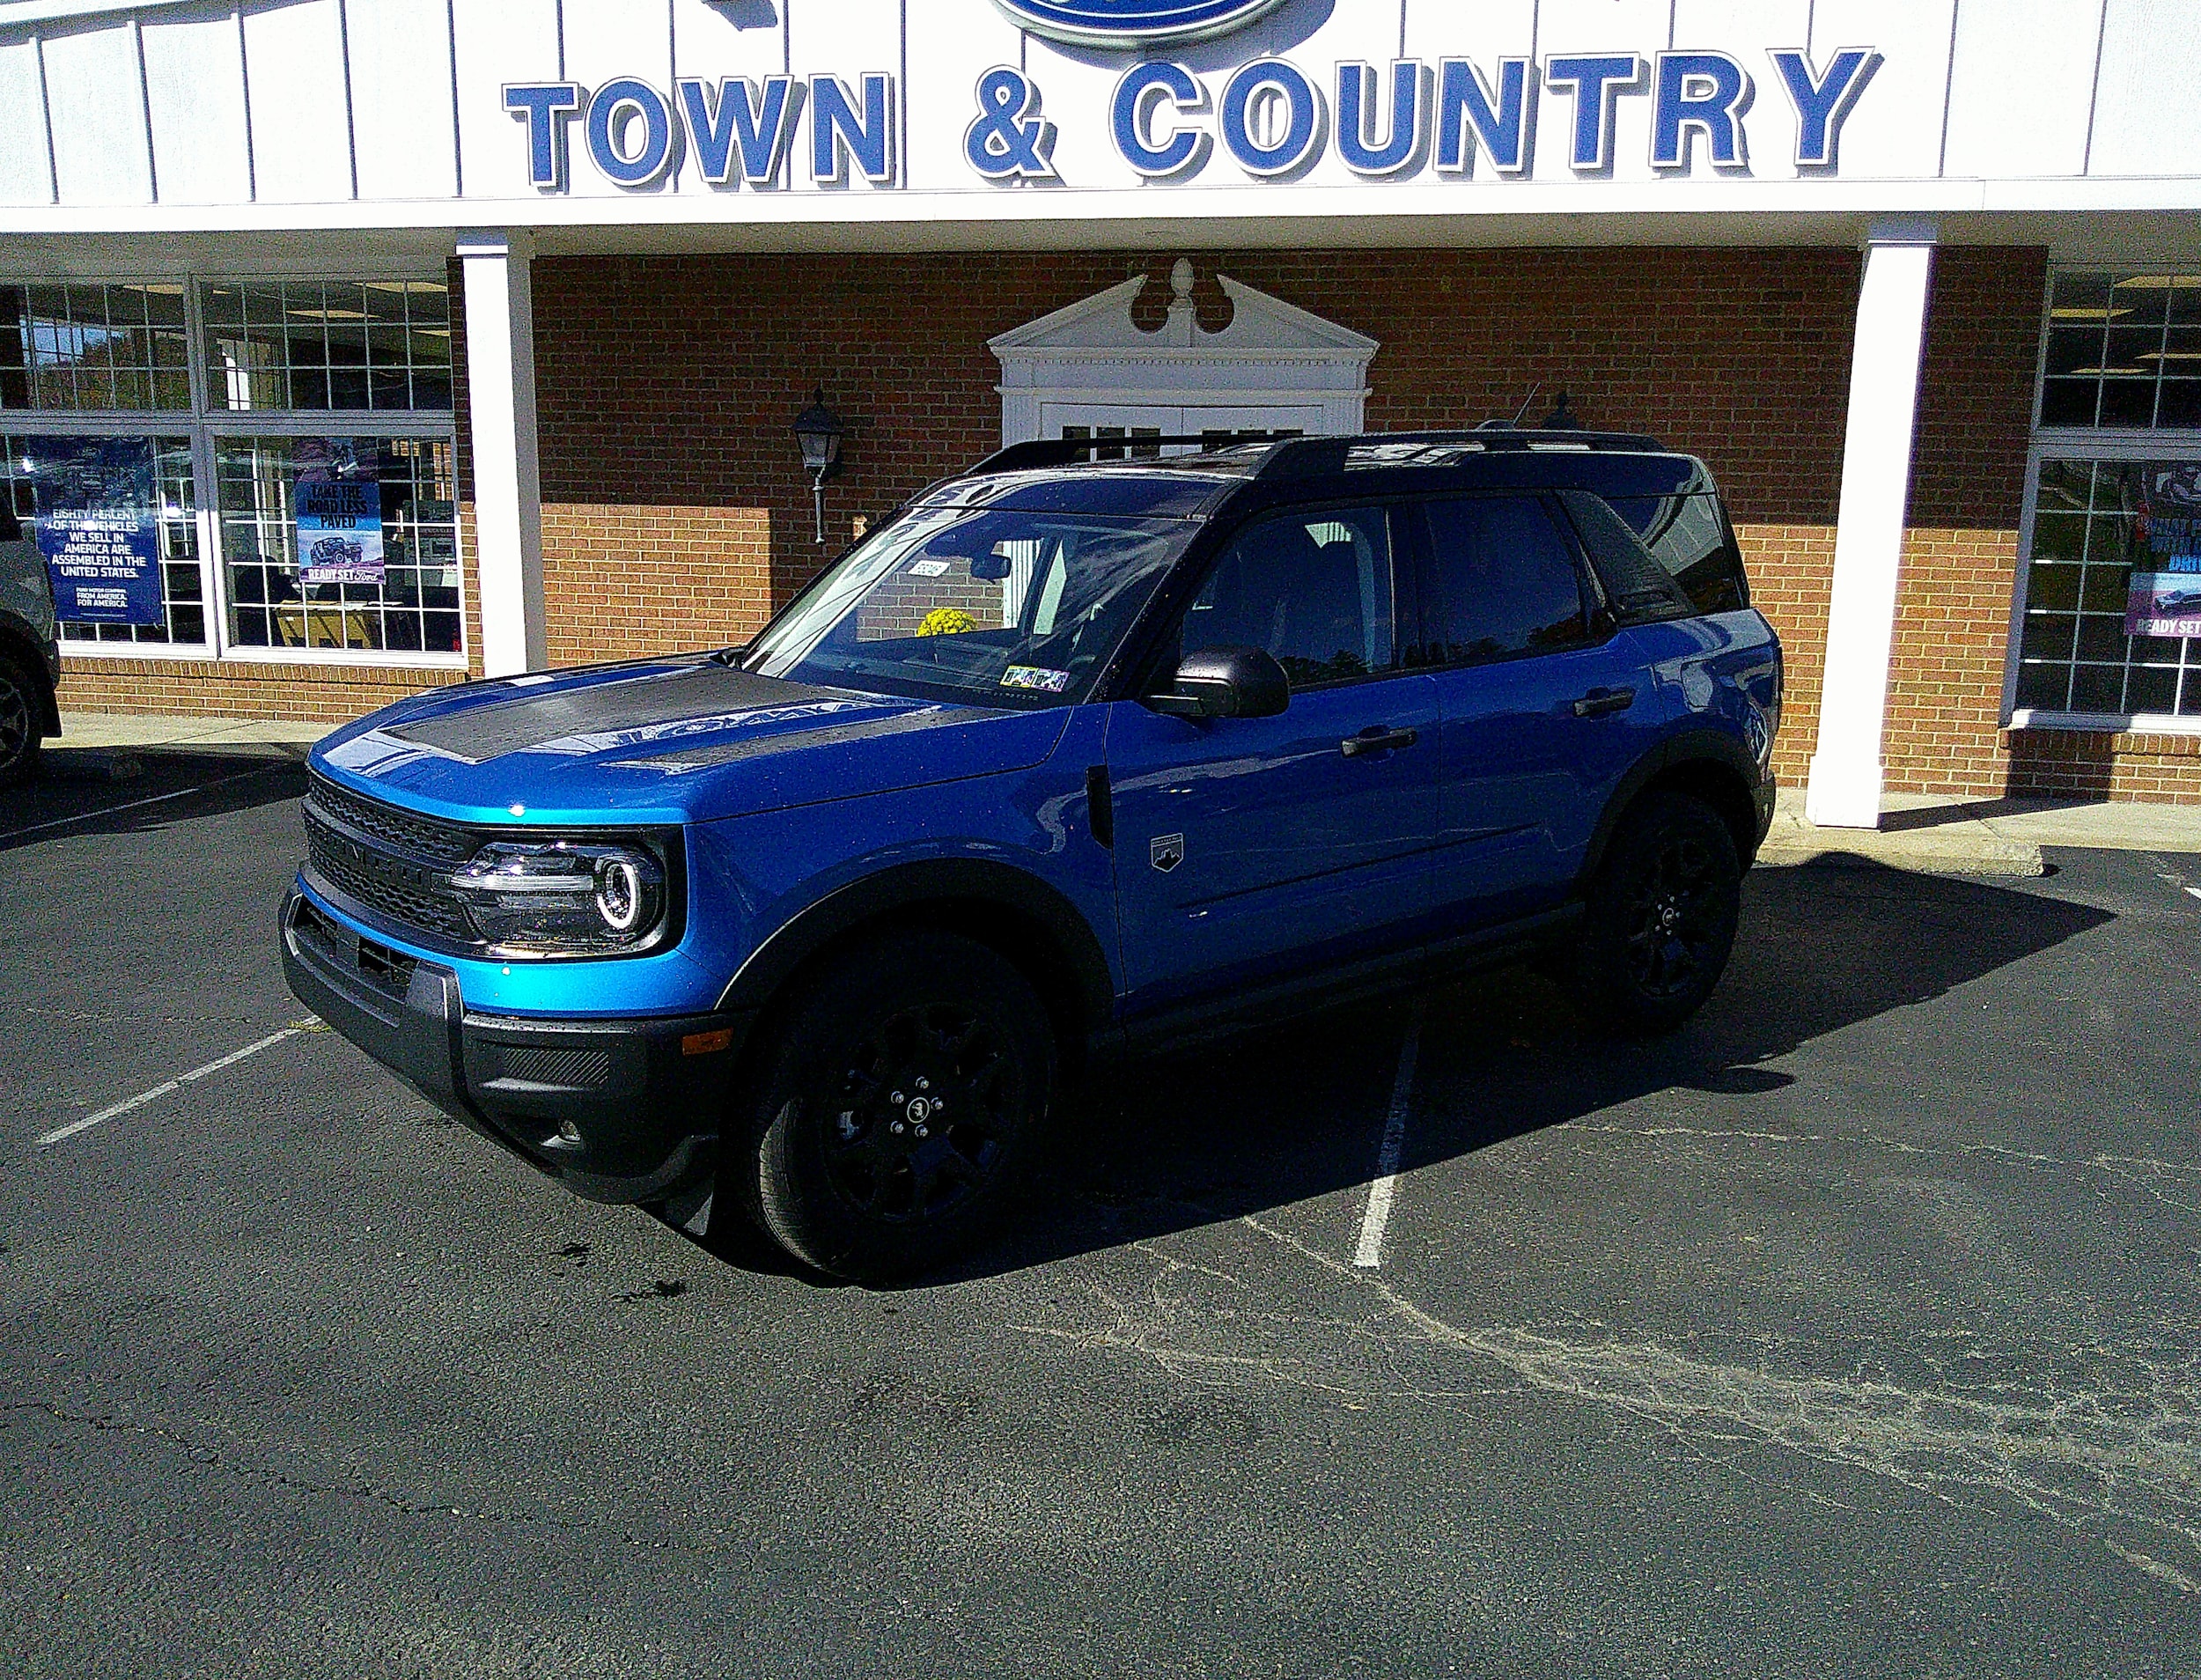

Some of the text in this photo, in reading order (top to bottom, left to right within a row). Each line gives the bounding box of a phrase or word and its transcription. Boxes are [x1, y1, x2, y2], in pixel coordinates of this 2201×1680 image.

[502, 46, 1876, 188] TOWN & COUNTRY
[340, 485, 363, 499] THE
[307, 499, 368, 514] ROAD LESS
[53, 521, 69, 531] OF
[70, 521, 90, 531] TH
[320, 514, 357, 528] PAVED
[69, 532, 124, 543] WE SELL IN
[64, 543, 132, 556] AMERICA ARE
[51, 555, 148, 567] ASSEMBLED IN THE
[61, 566, 140, 578] UNITED STATES.
[307, 568, 379, 581] READY SET Ford
[2136, 618, 2178, 634] READY
